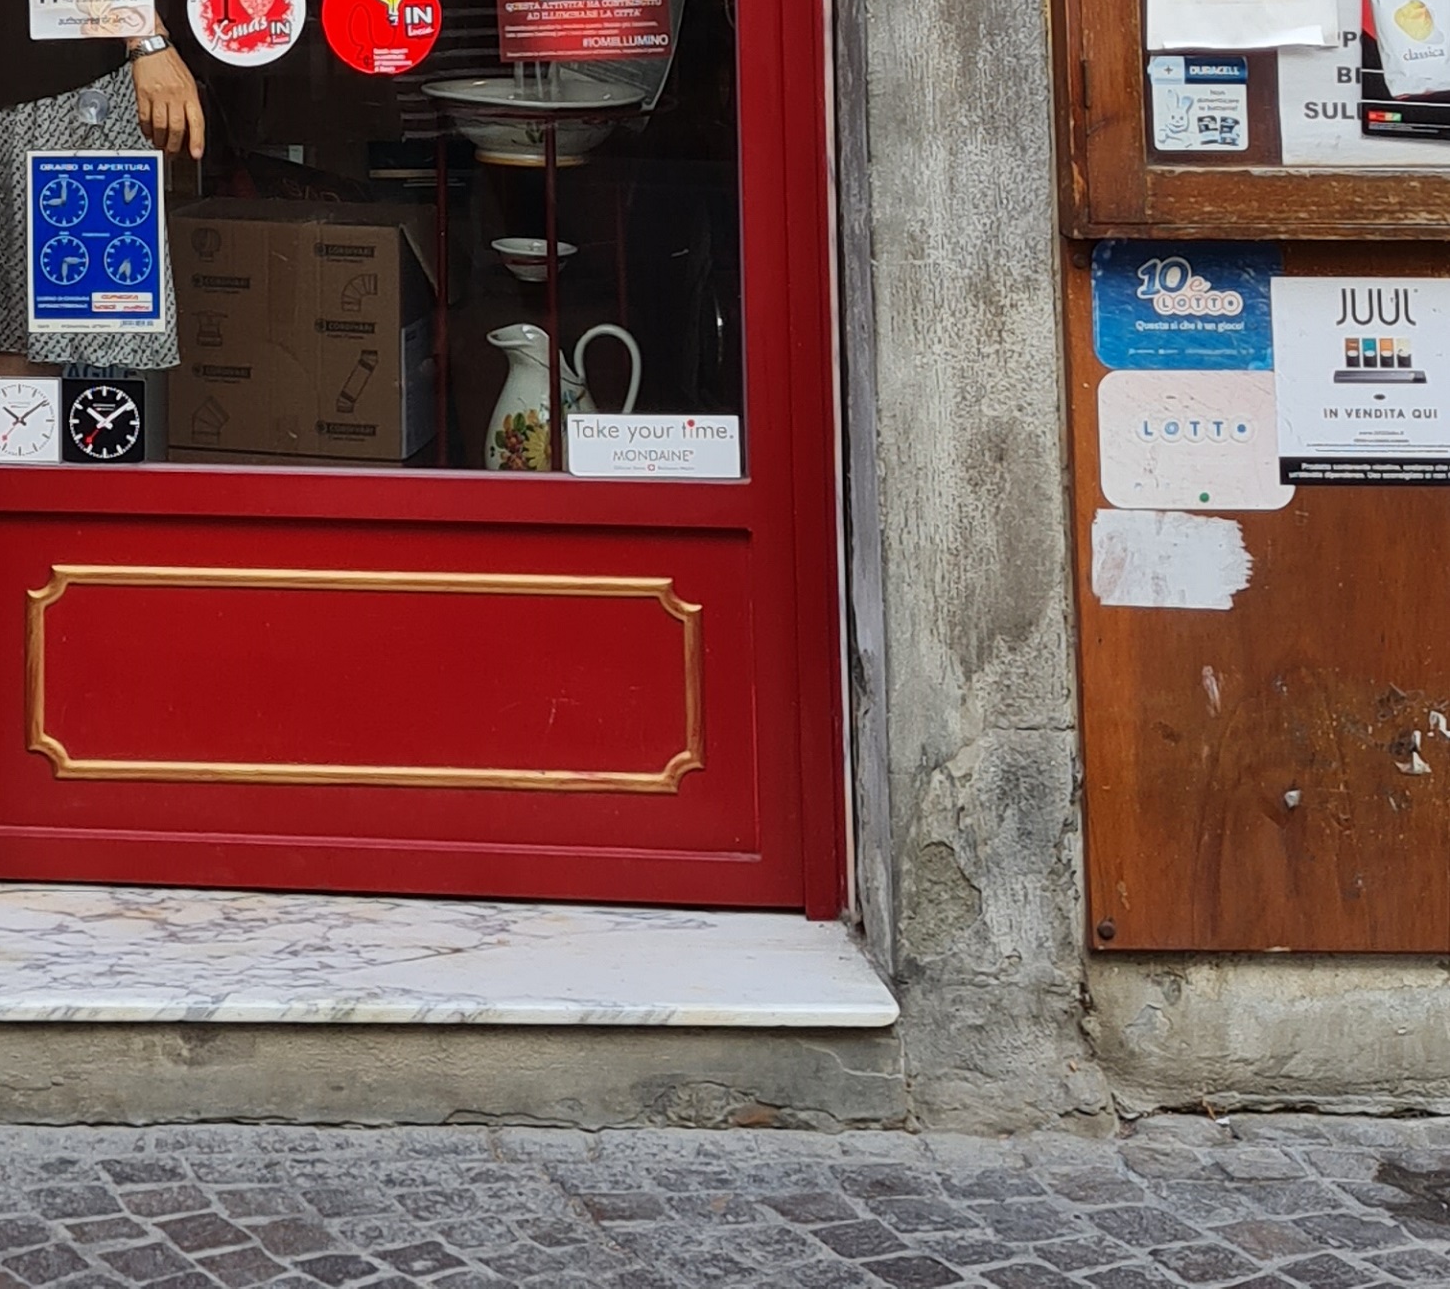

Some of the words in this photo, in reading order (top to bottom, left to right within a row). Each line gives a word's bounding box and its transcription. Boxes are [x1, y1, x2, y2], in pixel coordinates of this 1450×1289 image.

[405, 6, 433, 24] IN
[211, 16, 268, 51] Xmas
[1190, 66, 1240, 76] DURACELL
[97, 163, 150, 171] APERTURA
[1336, 288, 1417, 326] JUUL
[1324, 408, 1338, 419] IN
[1345, 408, 1406, 419] VENDITA
[1412, 408, 1438, 419] QUI
[571, 419, 620, 439] Take
[627, 424, 673, 443] your
[681, 419, 734, 439] time.
[613, 449, 690, 462] MONDAINE
